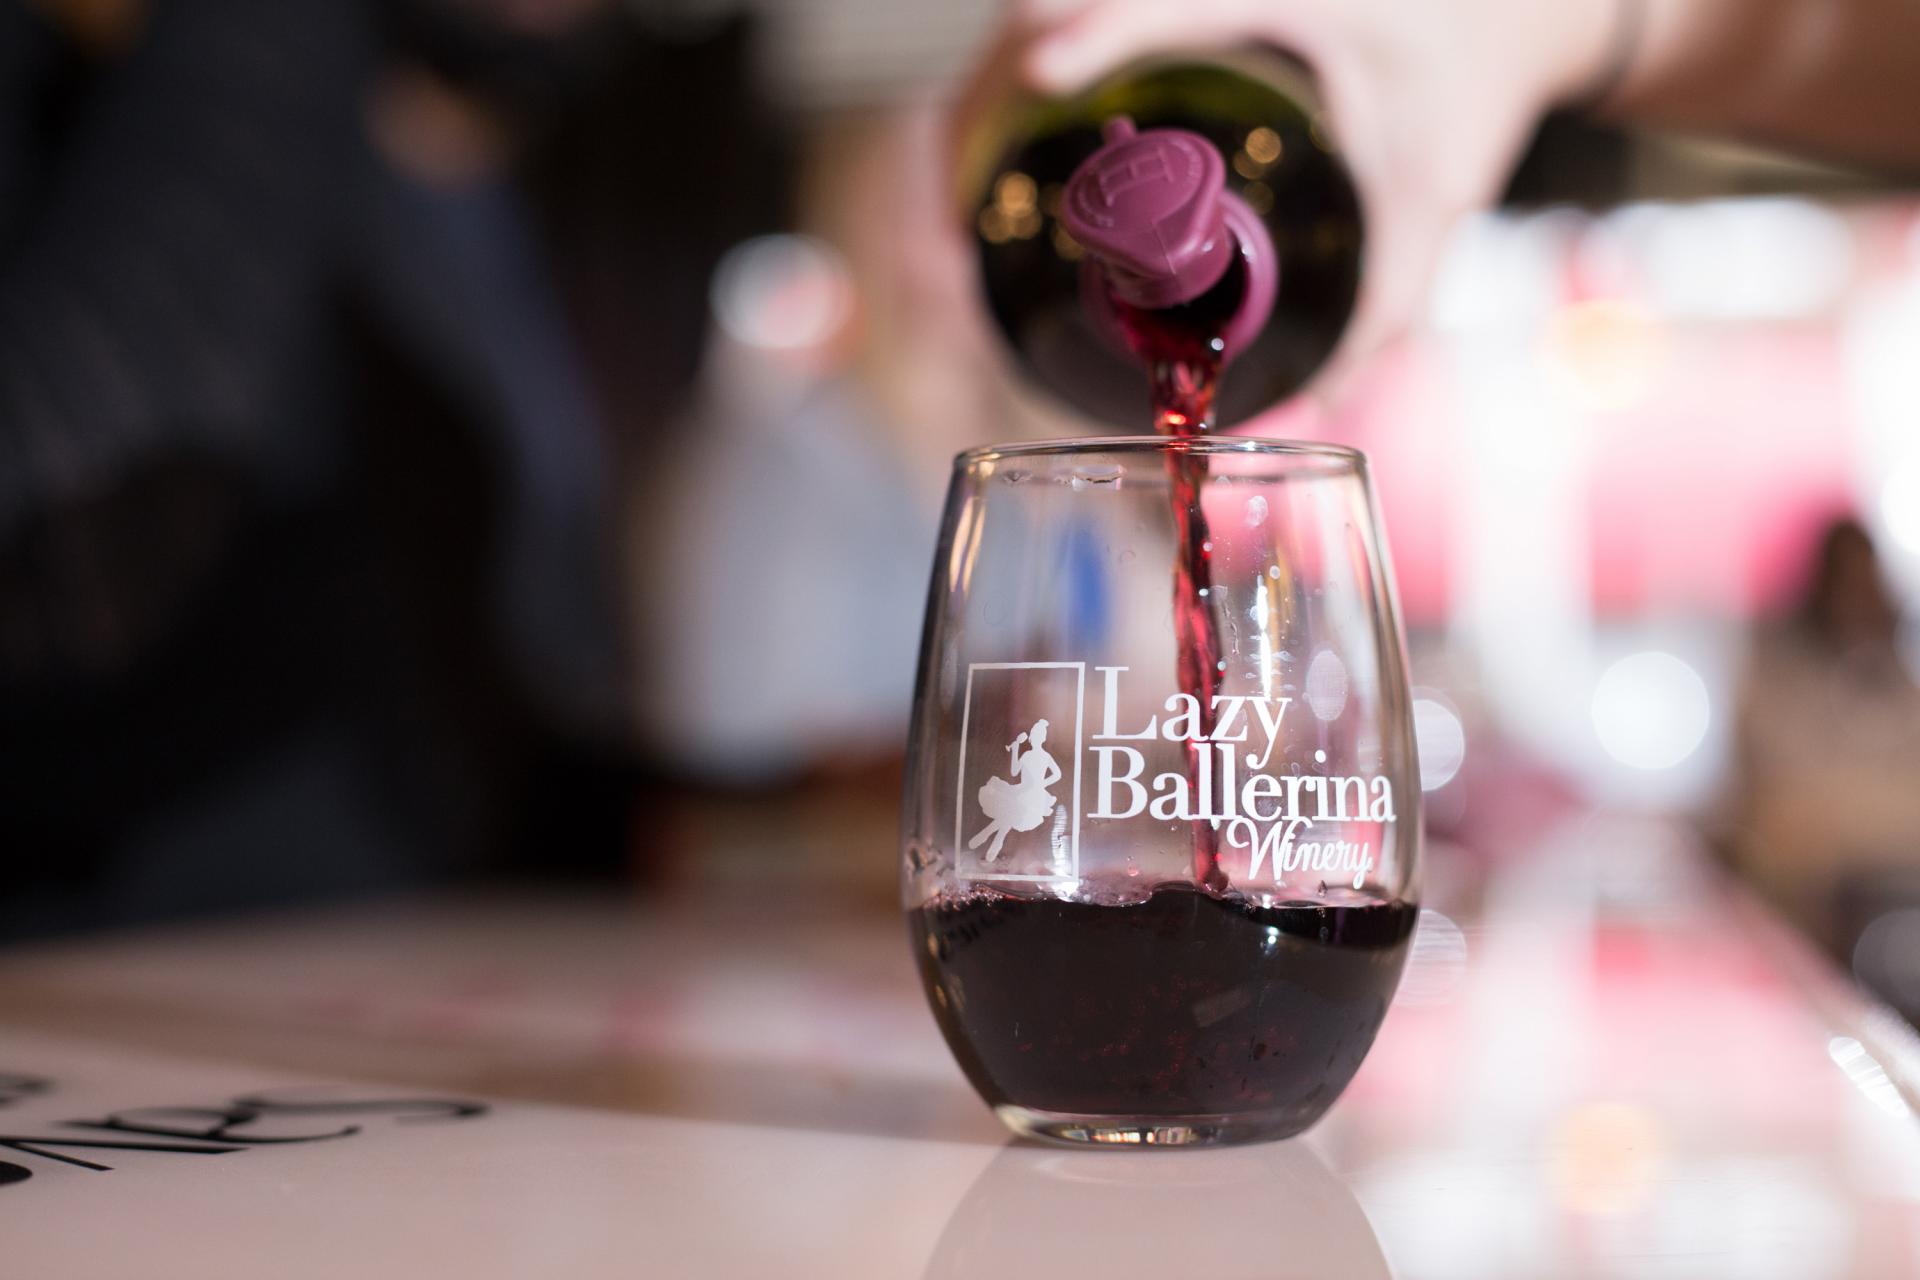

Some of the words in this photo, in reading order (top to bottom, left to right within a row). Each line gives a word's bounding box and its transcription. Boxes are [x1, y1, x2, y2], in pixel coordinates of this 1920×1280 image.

[1092, 666, 1292, 769] Lazy
[1087, 742, 1397, 822] Ballerina
[1226, 817, 1372, 889] Winery
